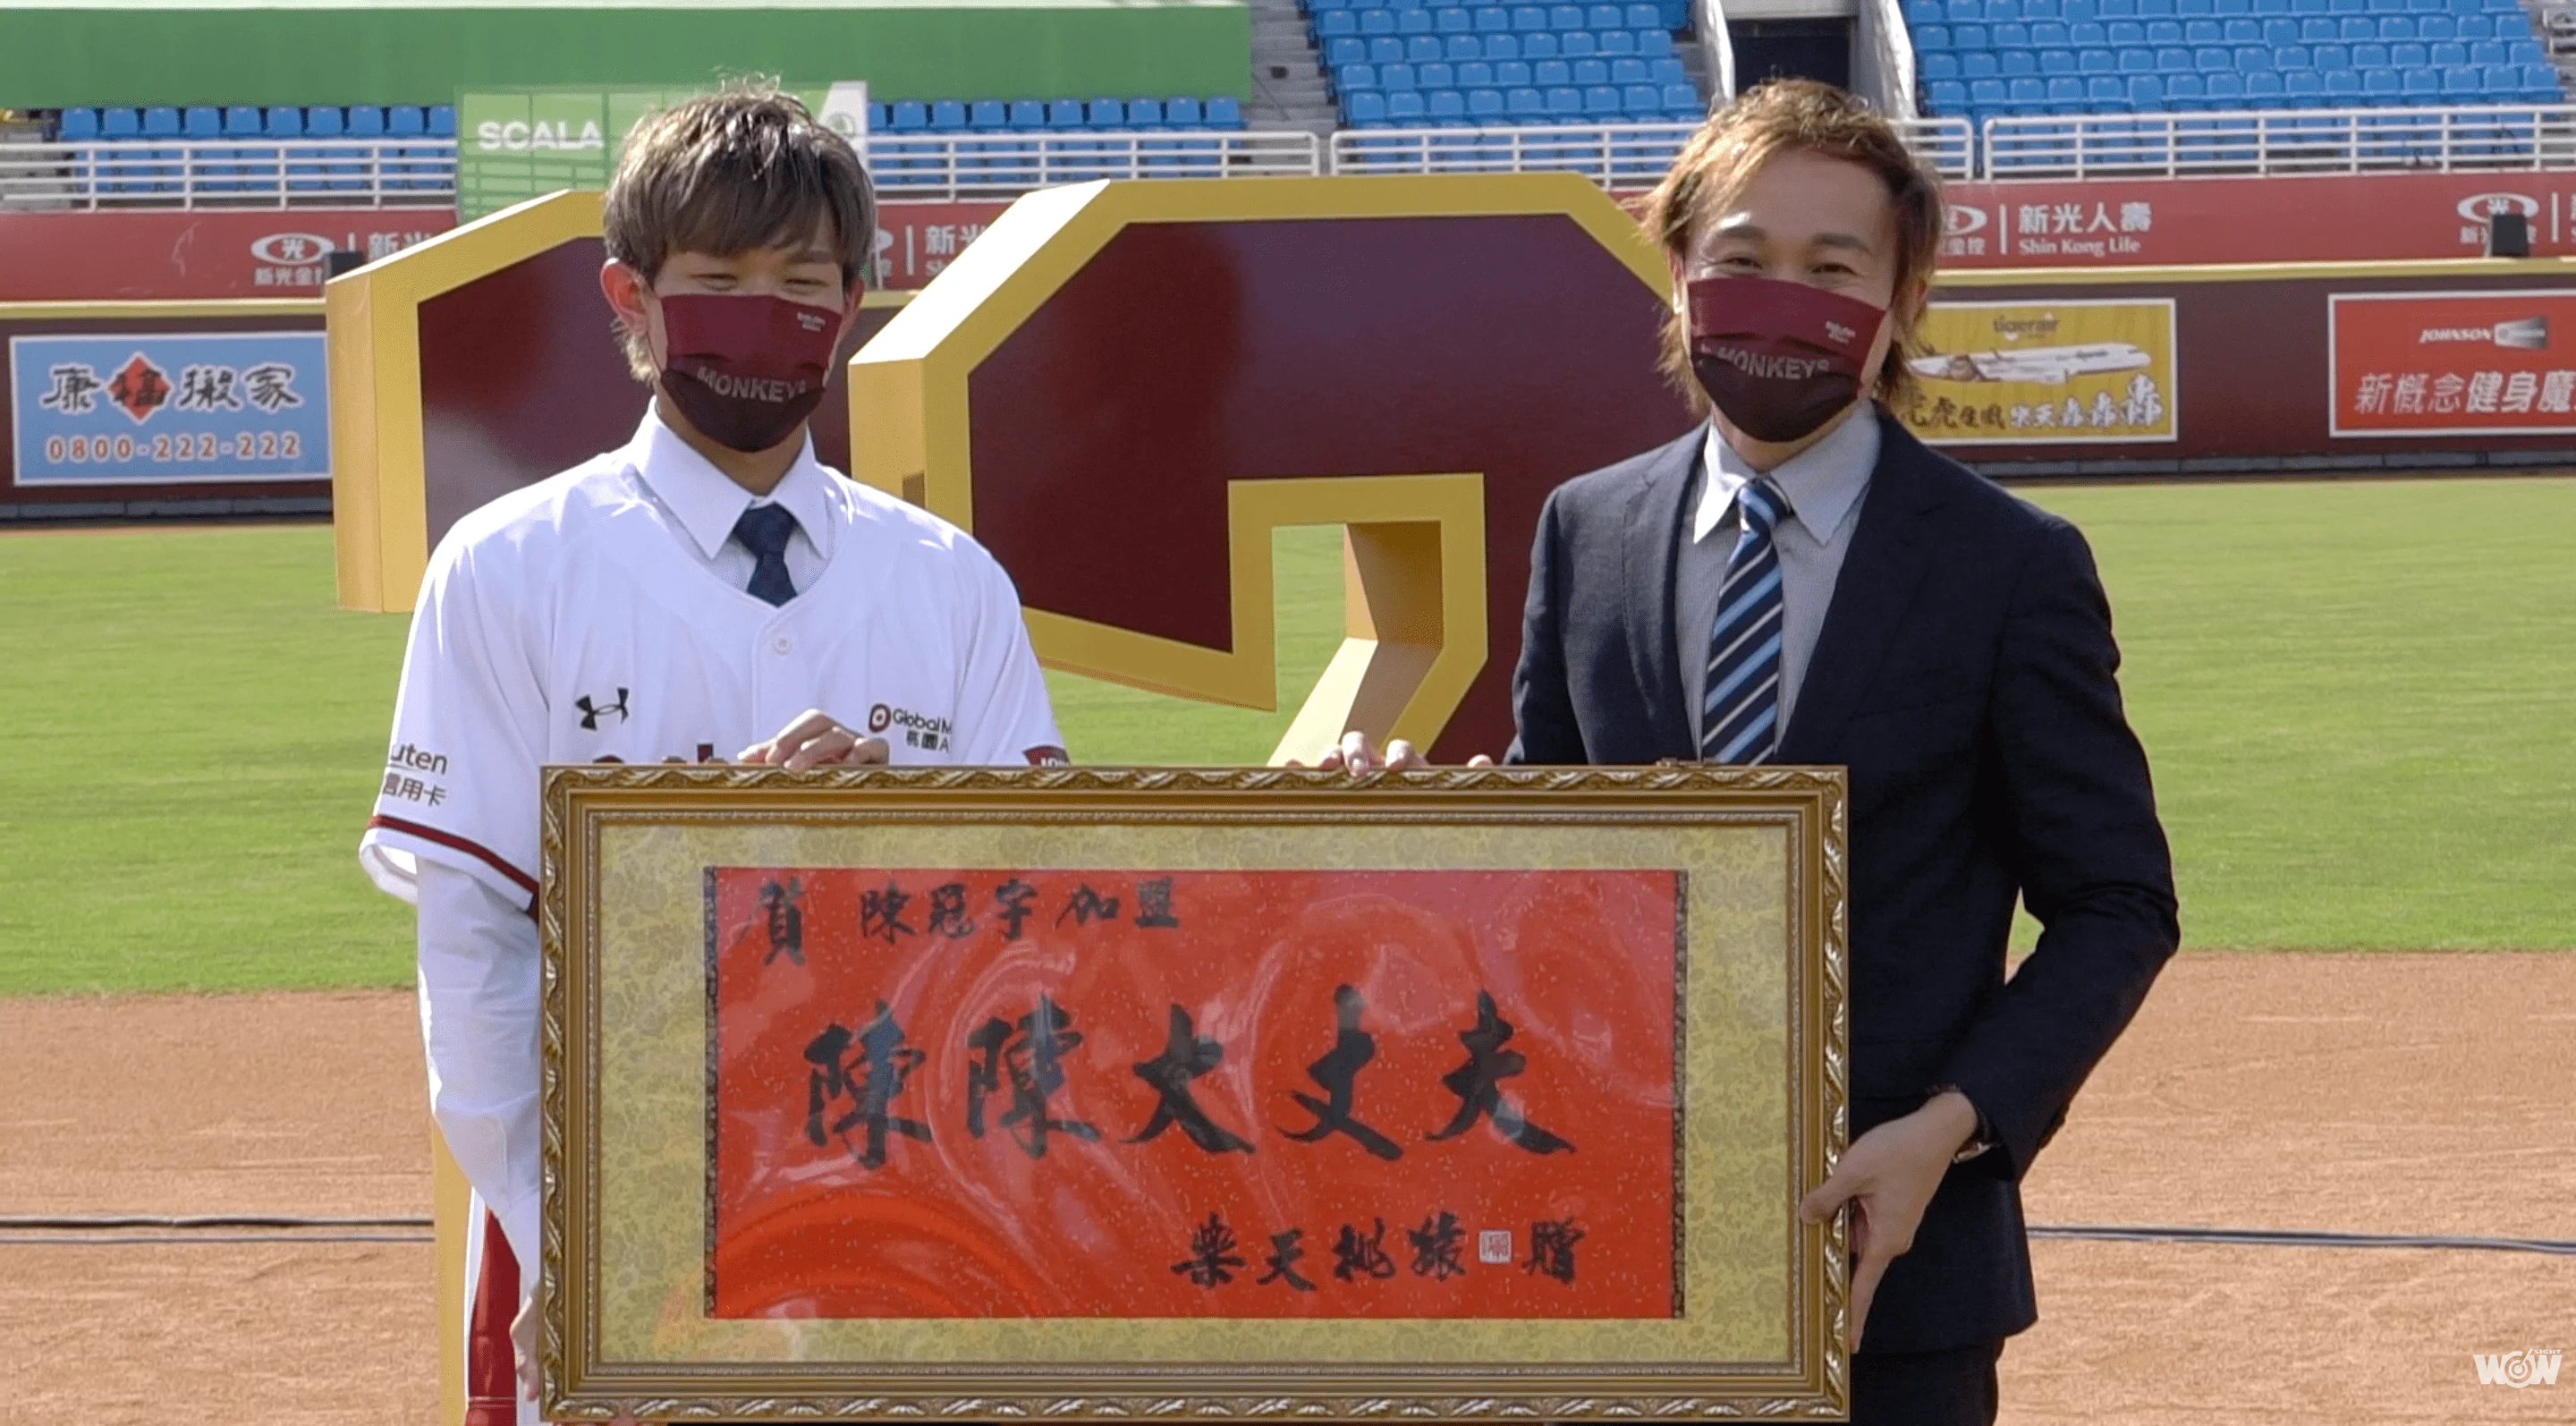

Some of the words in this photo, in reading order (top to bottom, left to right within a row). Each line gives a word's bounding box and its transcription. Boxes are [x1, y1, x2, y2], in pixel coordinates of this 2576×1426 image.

[478, 121, 604, 150] SCALA
[2018, 201, 2152, 233] 新光人壽
[2019, 238, 2056, 255] Shin
[2061, 238, 2106, 259] Kong
[2109, 236, 2141, 254] Life
[2419, 328, 2493, 344] JOHNSON
[41, 362, 305, 413] 康福搬家
[46, 432, 302, 463] 0800-222-222
